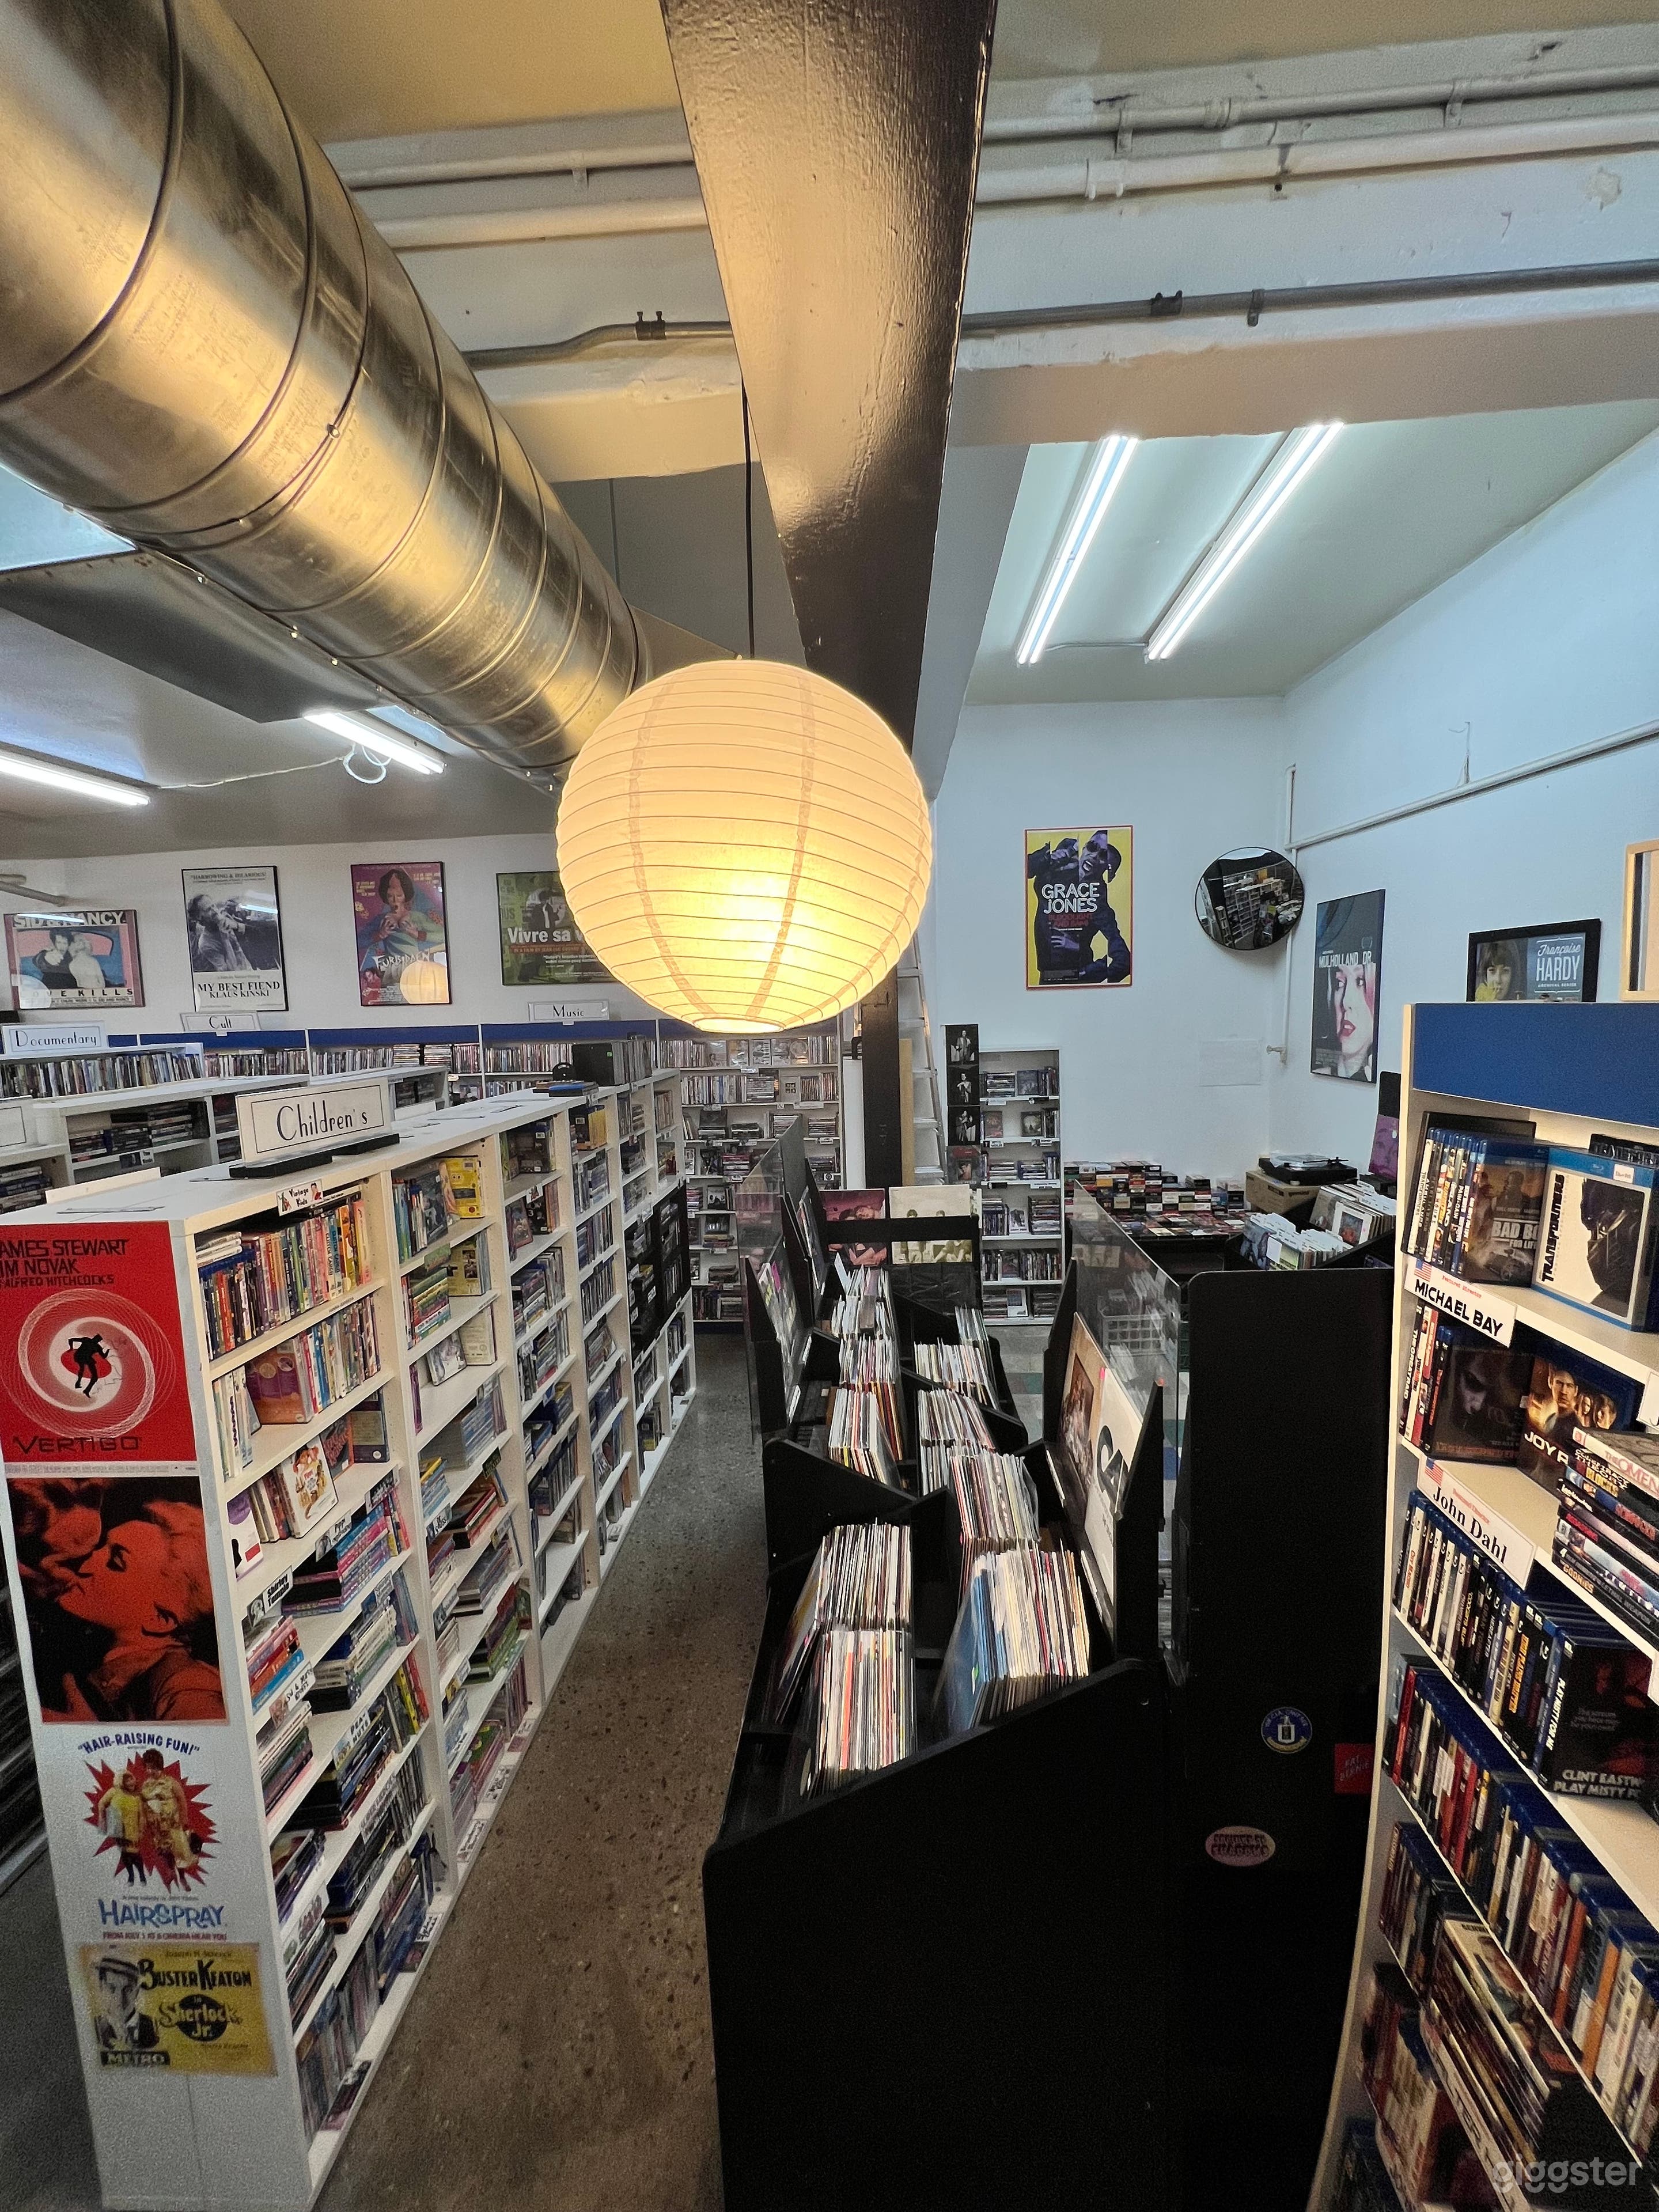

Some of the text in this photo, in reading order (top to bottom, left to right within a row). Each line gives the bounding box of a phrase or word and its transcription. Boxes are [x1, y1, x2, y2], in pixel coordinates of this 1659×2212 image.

[1041, 882, 1100, 899] GRACE
[1043, 897, 1097, 914] JONES
[507, 927, 548, 944] Vivre
[553, 930, 571, 942] sa
[1319, 952, 1358, 968] MULHOLLAND
[1537, 942, 1581, 956] Françoise
[1536, 955, 1580, 981] HARDY
[78, 988, 133, 997] KILLS
[198, 981, 281, 992] MY BEST FIEND
[552, 1004, 585, 1018] Music
[15, 1029, 97, 1047] Documentary
[276, 1099, 368, 1142] Children's
[289, 1188, 309, 1198] Vintage
[296, 1198, 308, 1207] Kids
[1418, 1177, 1430, 1228] AMBULANCE
[1491, 1221, 1521, 1239] BAD
[1541, 1174, 1565, 1282] TRANSFORMERS
[0, 1238, 130, 1259] AMES STEWART
[0, 1258, 81, 1278] IM NOVAK
[5, 1277, 44, 1288] ALFRED
[1415, 1278, 1503, 1337] MICHAEL BAY
[1407, 1346, 1415, 1380] GREAT
[13, 1435, 140, 1455] VERTIGO
[1524, 1431, 1556, 1456] JOY
[1575, 1448, 1631, 1486] CONSPIRACY
[1575, 1454, 1628, 1490] THEORY
[1618, 1457, 1659, 1494] OMEN
[1433, 1486, 1507, 1564] John Dahl
[267, 1573, 288, 1599] Shirley
[1563, 1564, 1594, 1594] GOONIES
[268, 1582, 290, 1608] Temple
[1484, 1615, 1495, 1658] HEREAFTER
[1514, 1653, 1527, 1683] PLAINS
[1509, 1679, 1521, 1714] DRIFTER
[1546, 1677, 1566, 1751] PLAY MISTY FOR ME
[77, 1732, 200, 1755] "HAIR-RAISING FUN!"
[352, 1719, 369, 1744] NUTS
[1562, 1769, 1599, 1782] CLINT
[1554, 1781, 1586, 1793] PLAY
[1586, 1785, 1626, 1797] MISTY
[98, 1899, 225, 1929] HAIRSPRAY
[137, 1959, 252, 1991] BUSTER KEATON
